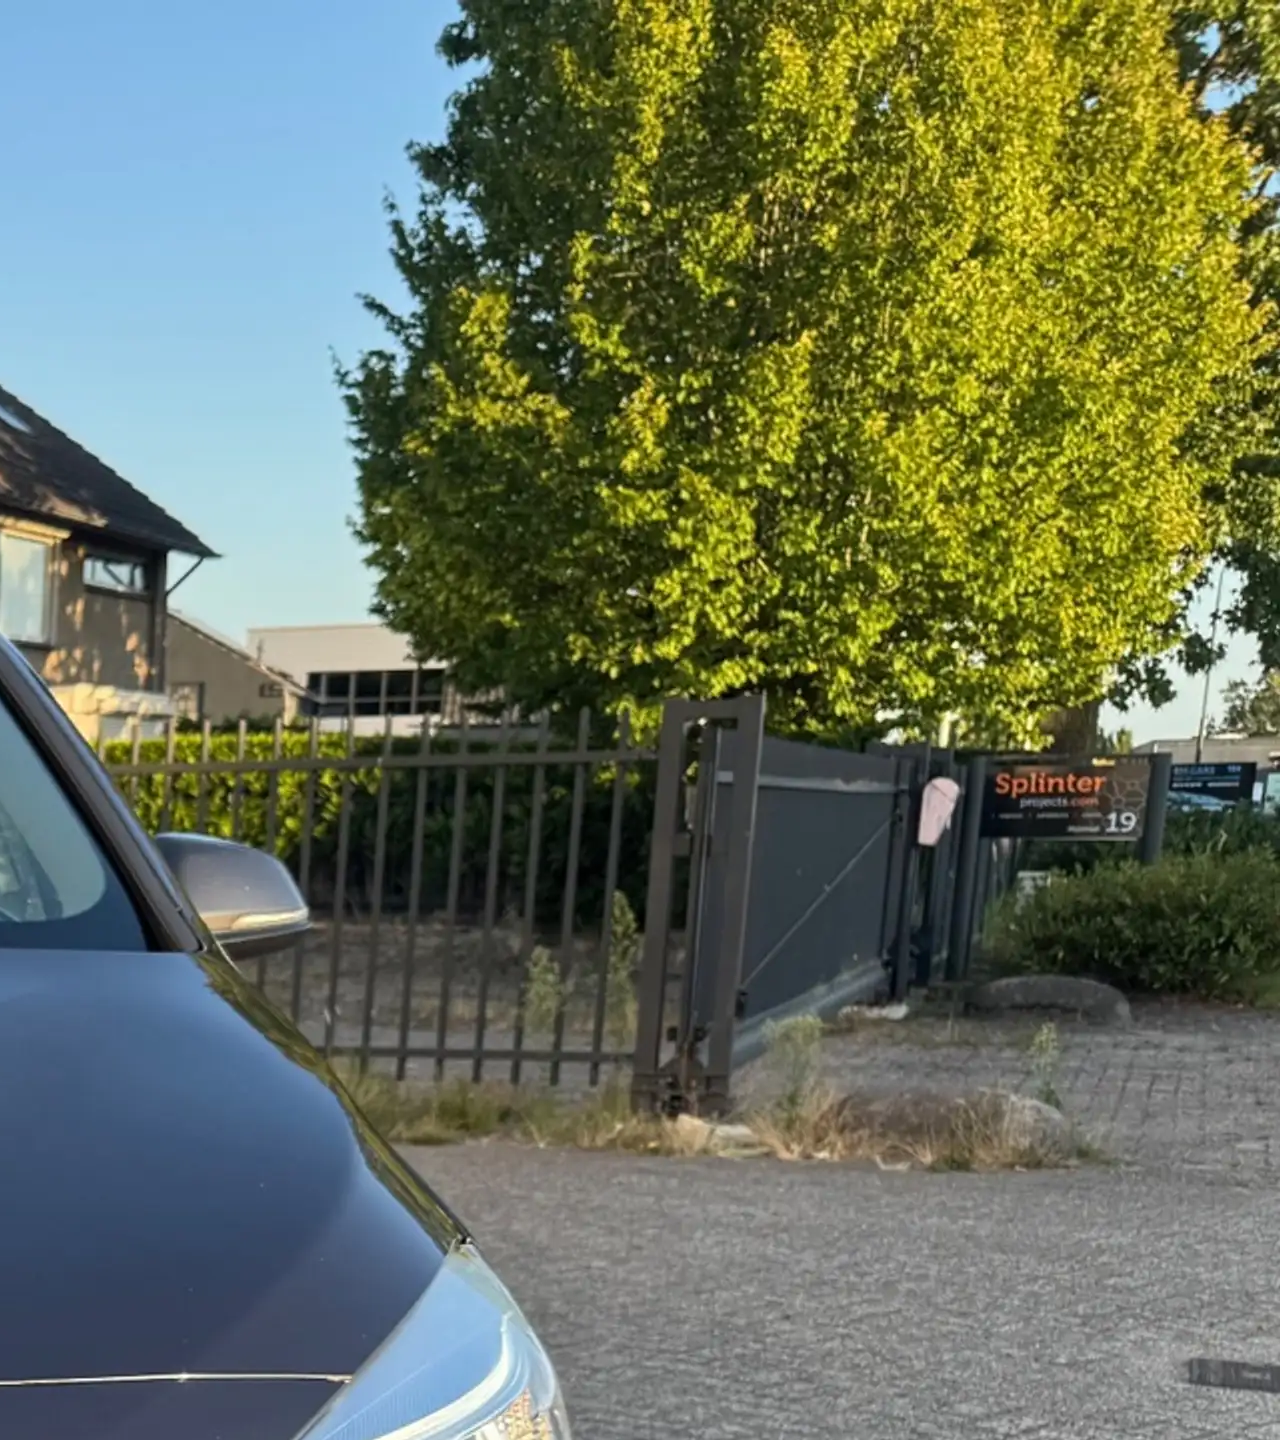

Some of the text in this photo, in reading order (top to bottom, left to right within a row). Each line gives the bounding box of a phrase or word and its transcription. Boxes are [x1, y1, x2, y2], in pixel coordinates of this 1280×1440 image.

[995, 771, 1107, 798] Splinter
[1020, 797, 1100, 809] projects.com
[1105, 811, 1138, 833] 19
